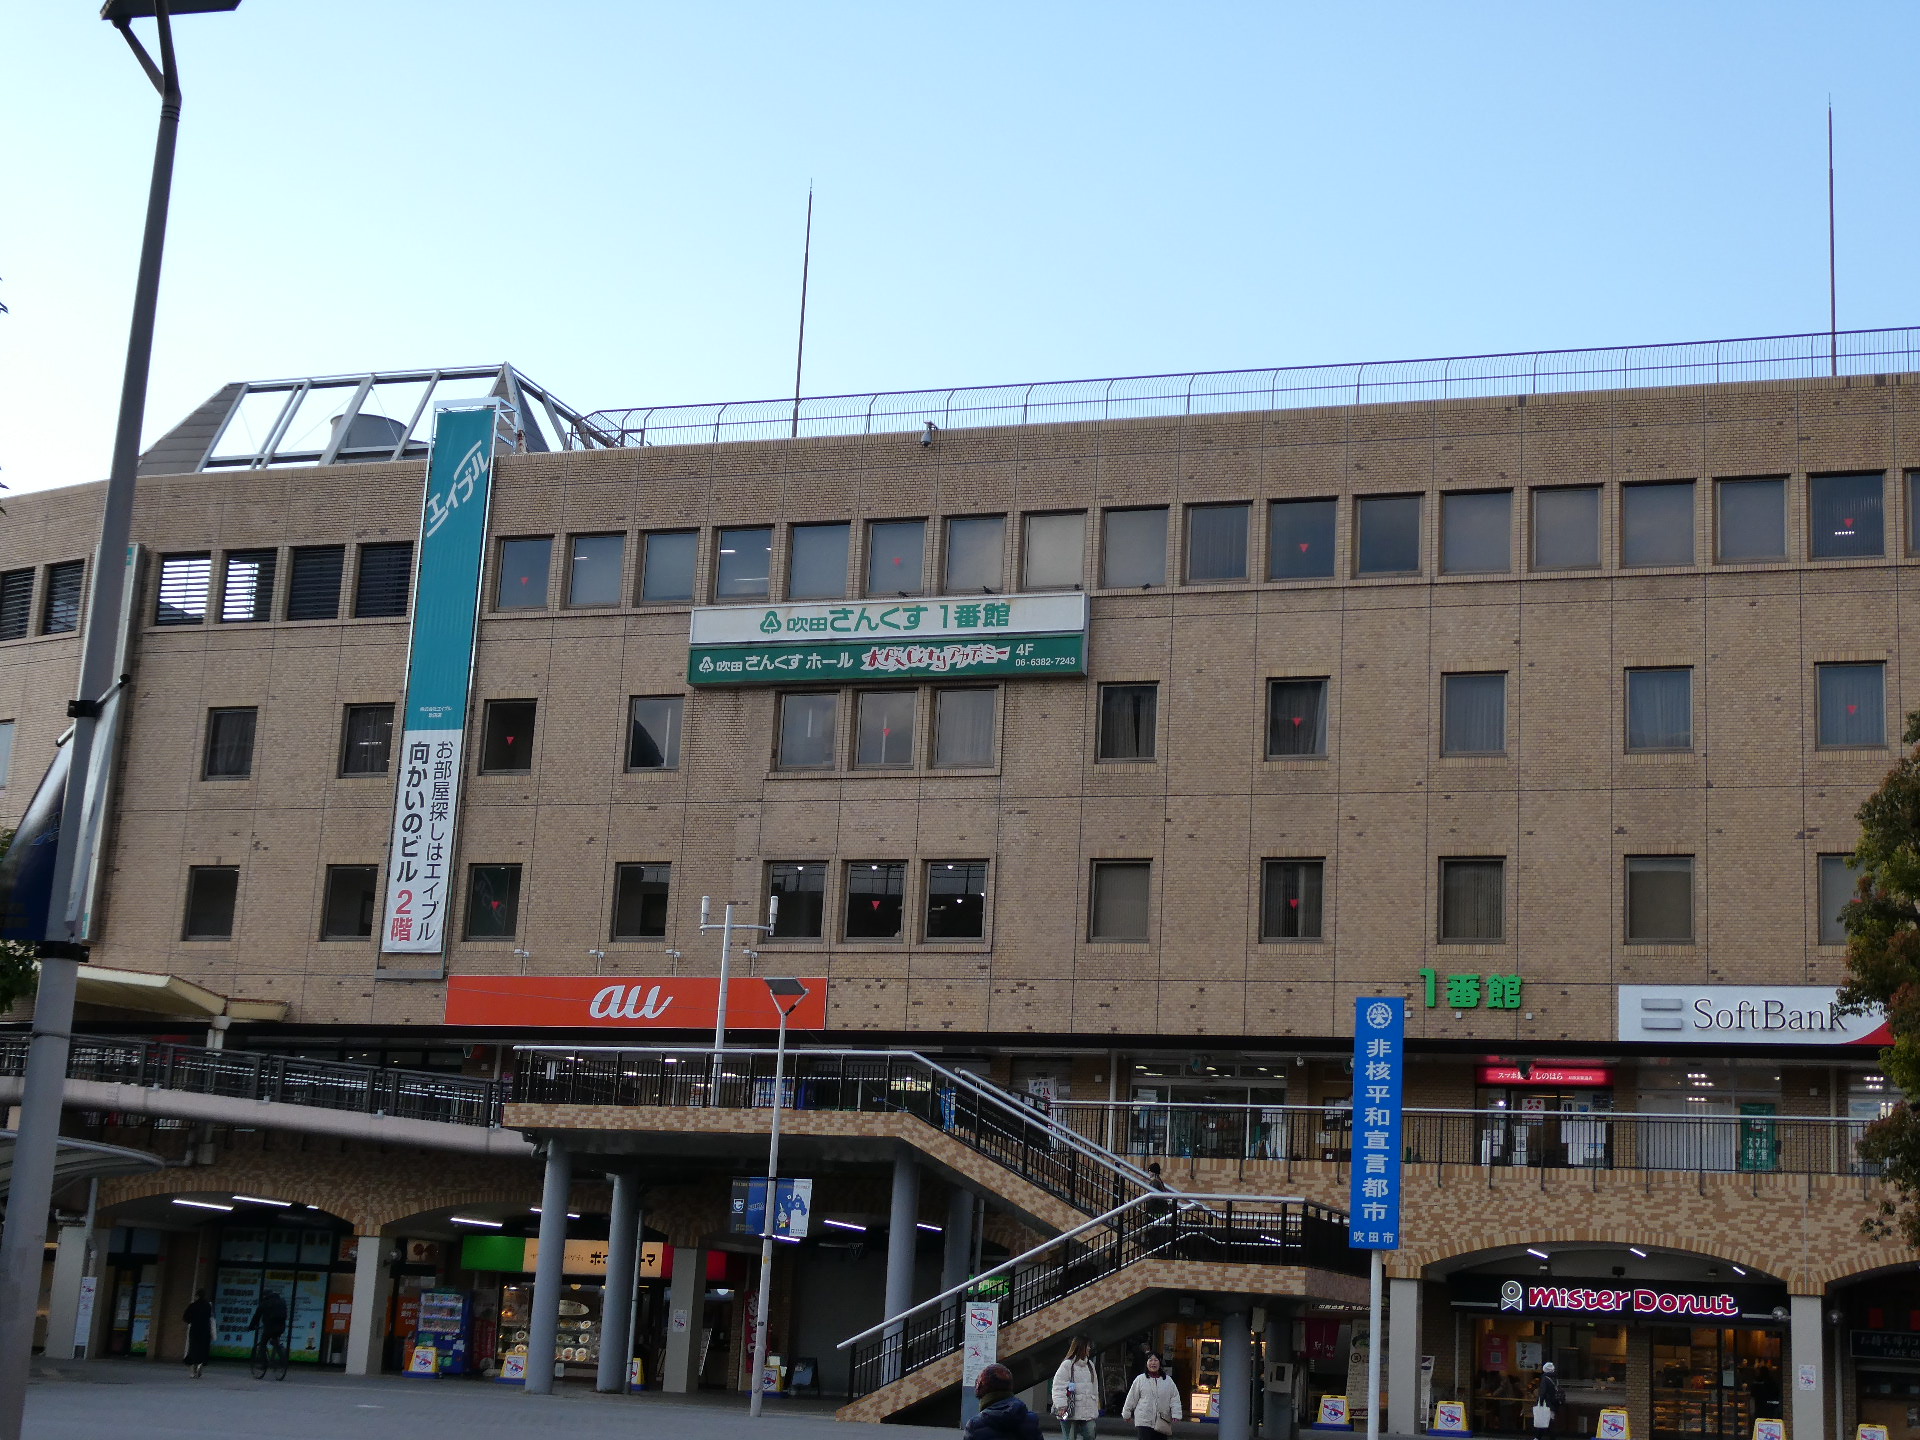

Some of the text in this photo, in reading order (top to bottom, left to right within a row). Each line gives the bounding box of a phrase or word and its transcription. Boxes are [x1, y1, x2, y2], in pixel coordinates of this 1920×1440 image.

[427, 446, 491, 530] エイブル
[1015, 657, 1076, 667] 06-6382-7243
[1016, 643, 1035, 656] 4F
[416, 740, 453, 942] お部屋探しはエイブル
[589, 984, 674, 1019] au
[1419, 967, 1523, 1009] 1番館
[1693, 998, 1848, 1032] SoftBank
[1361, 1038, 1392, 1222] 非核平和宣言都市
[1353, 1230, 1395, 1244] 吹田市
